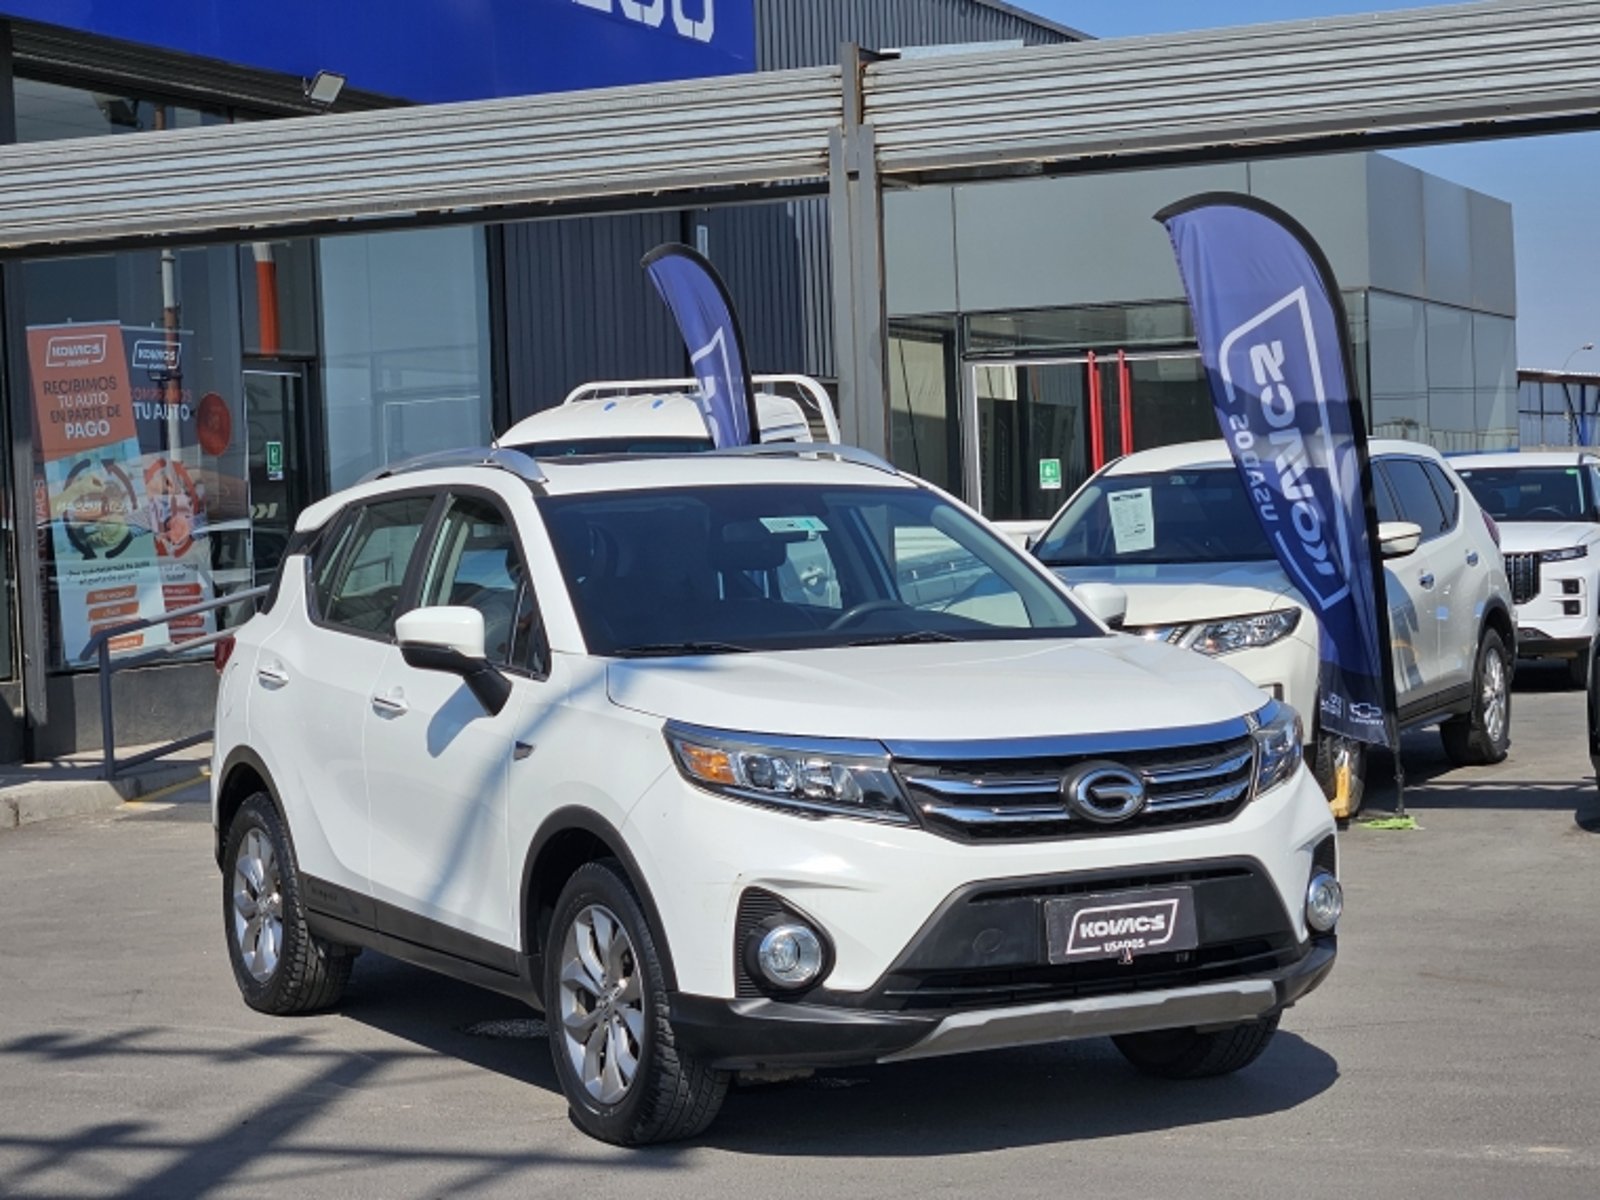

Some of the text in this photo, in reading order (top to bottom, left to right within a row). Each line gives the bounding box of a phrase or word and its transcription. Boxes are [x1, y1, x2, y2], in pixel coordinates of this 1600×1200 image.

[43, 376, 117, 395] RECIBIMOS
[57, 391, 110, 407] TU AUTO
[68, 407, 105, 422] PARTE
[107, 404, 121, 418] DE
[132, 401, 191, 421] TU AUTO
[64, 420, 111, 440] PAGO
[1079, 913, 1166, 939] KOVACS
[1103, 938, 1146, 953] USADOS
